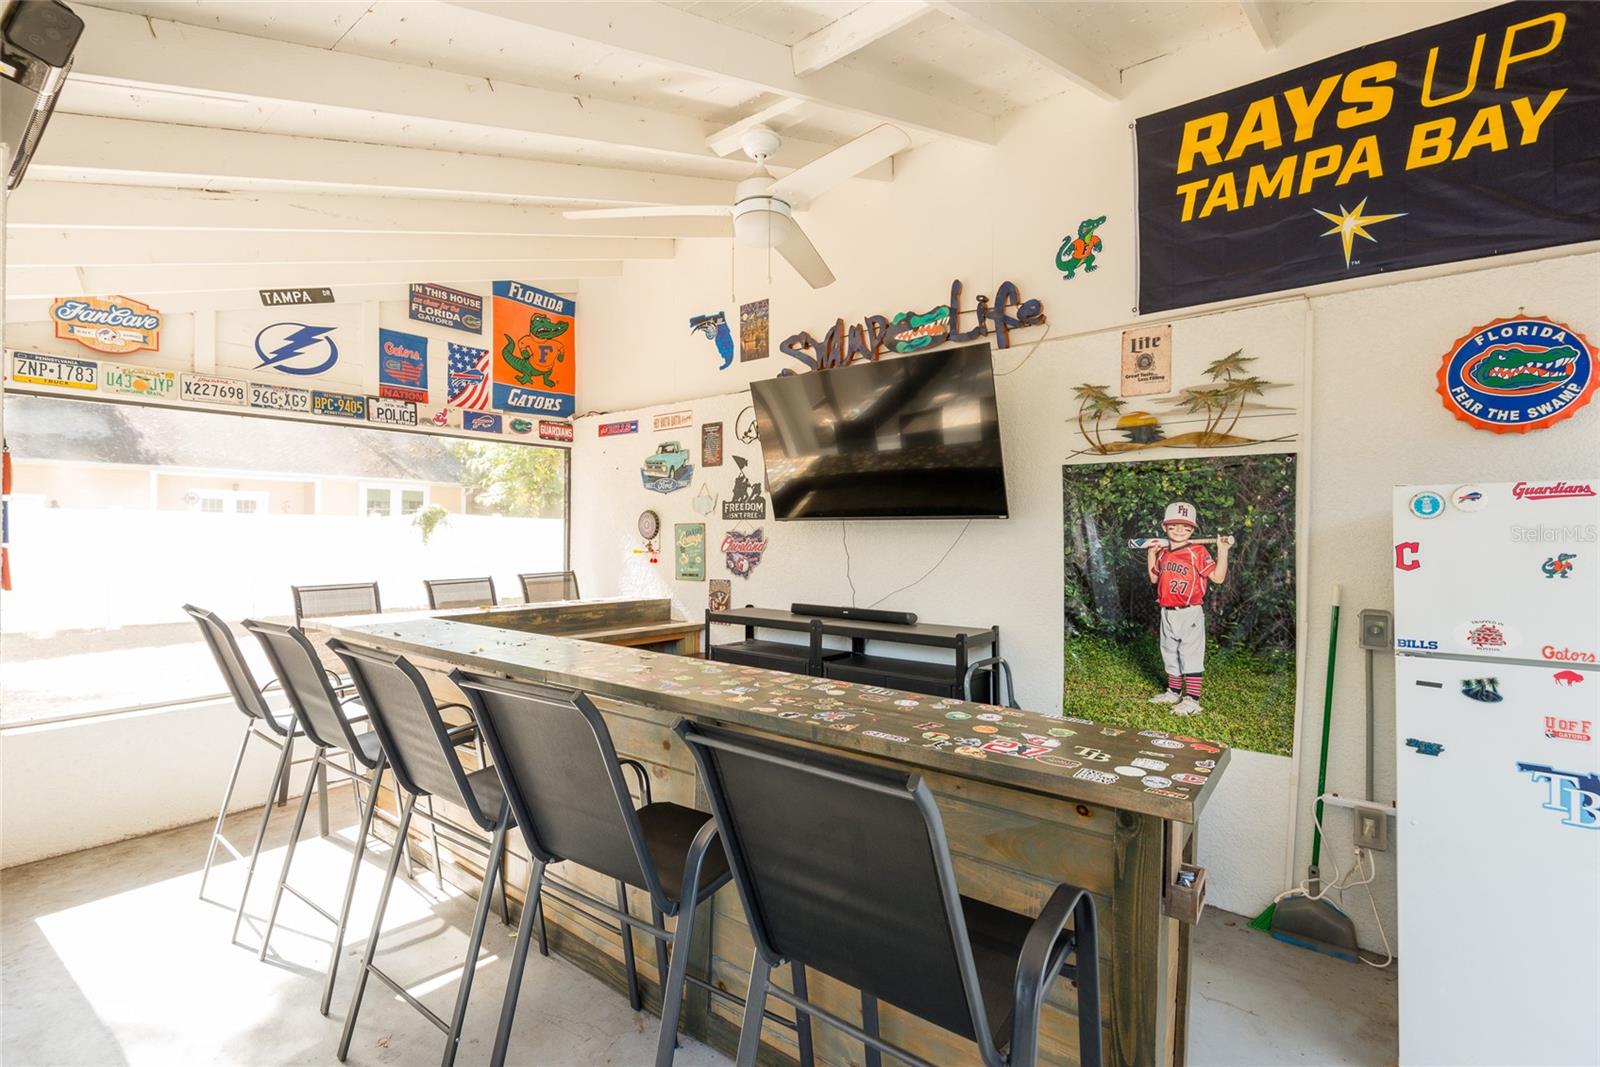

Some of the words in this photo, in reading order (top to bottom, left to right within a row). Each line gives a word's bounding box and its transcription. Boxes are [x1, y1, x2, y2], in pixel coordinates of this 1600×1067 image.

[1176, 60, 1398, 176] RAYS
[1421, 12, 1567, 108] UP
[1175, 135, 1384, 223] TAMPA
[1405, 88, 1568, 171] BAY
[262, 291, 312, 304] TAMPA
[322, 289, 332, 297] DR
[412, 284, 422, 293] IN
[425, 287, 448, 300] THIS
[450, 293, 481, 308] HOUSE
[508, 281, 564, 313] FLORIDA
[412, 303, 461, 321] FLORIDA
[417, 313, 454, 326] GATORS
[949, 279, 1047, 350] Life
[1131, 336, 1161, 354] Lite
[1474, 325, 1566, 347] FLORIDA
[35, 356, 78, 365] PENNSYLVANIA
[538, 345, 553, 363] F
[150, 378, 174, 392] JYP
[184, 381, 244, 400] X227698
[384, 388, 423, 402] NATION
[507, 388, 562, 412] GATORS
[1452, 386, 1483, 414] FEAR
[1487, 408, 1520, 421] THE
[1527, 382, 1580, 419] SWAMP
[377, 407, 416, 423] POLICE
[540, 425, 573, 437] GUARDIANS
[1512, 481, 1597, 500] Guardians
[724, 502, 764, 513] FREEDOM
[1395, 542, 1421, 571] C
[1170, 579, 1188, 595] 27
[1397, 638, 1438, 650] BILLS
[1541, 645, 1596, 662] Gators
[1544, 716, 1555, 731] U
[1558, 719, 1578, 733] OF
[1581, 721, 1592, 735] F
[1558, 732, 1588, 741] GATORS
[1531, 770, 1600, 830] TB
